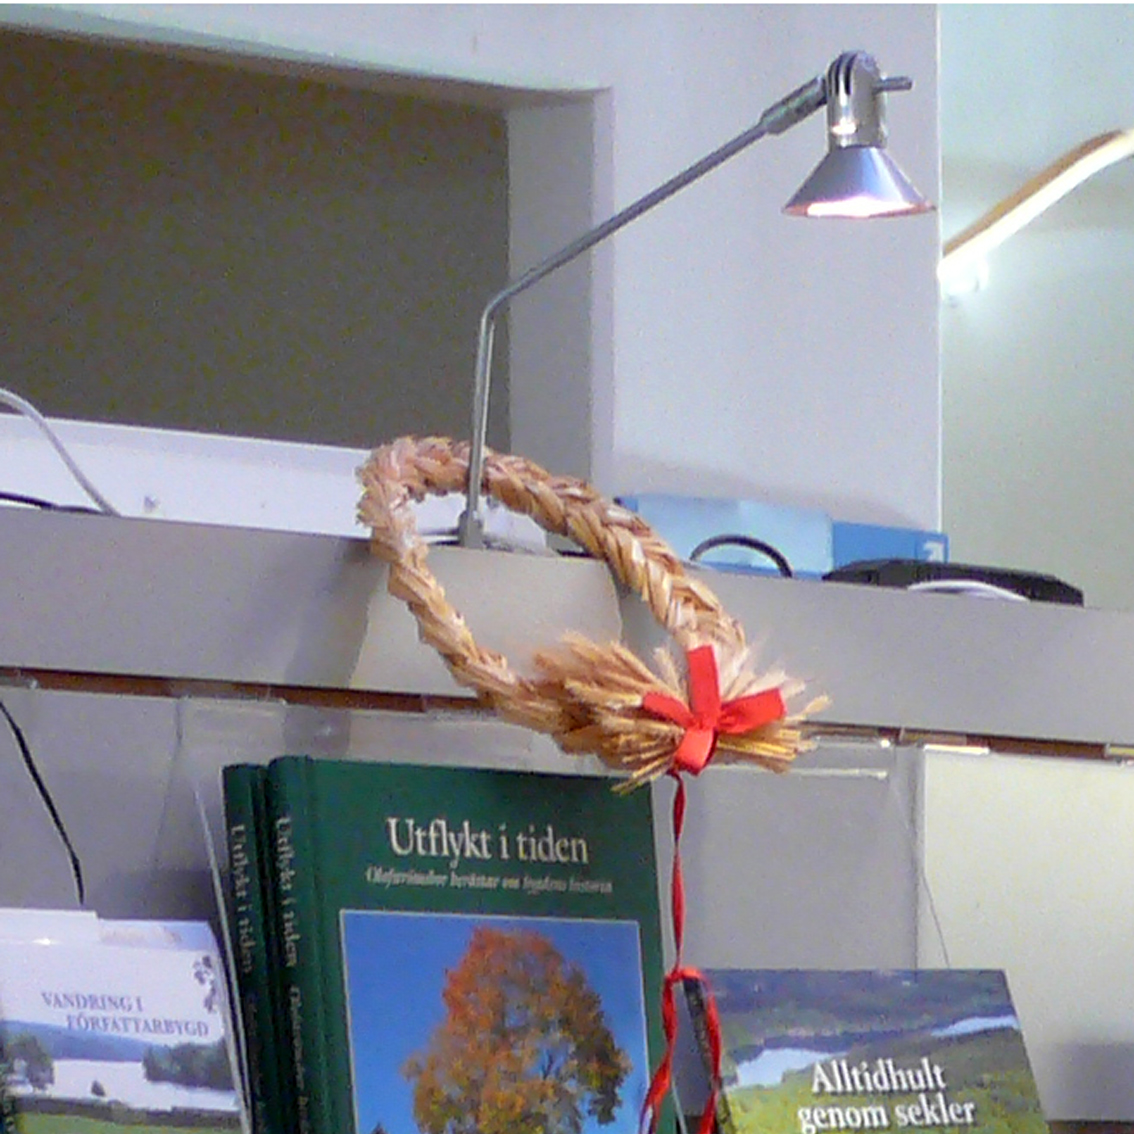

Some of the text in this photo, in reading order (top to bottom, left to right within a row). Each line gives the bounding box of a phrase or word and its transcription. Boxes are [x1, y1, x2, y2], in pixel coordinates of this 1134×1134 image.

[386, 817, 589, 869] Utflykt i tiden
[41, 991, 135, 1013] VANDRING
[66, 1013, 209, 1037] FÖRFATTARBYGD
[811, 1057, 948, 1094] Alltidhult
[893, 1094, 976, 1127] sekler
